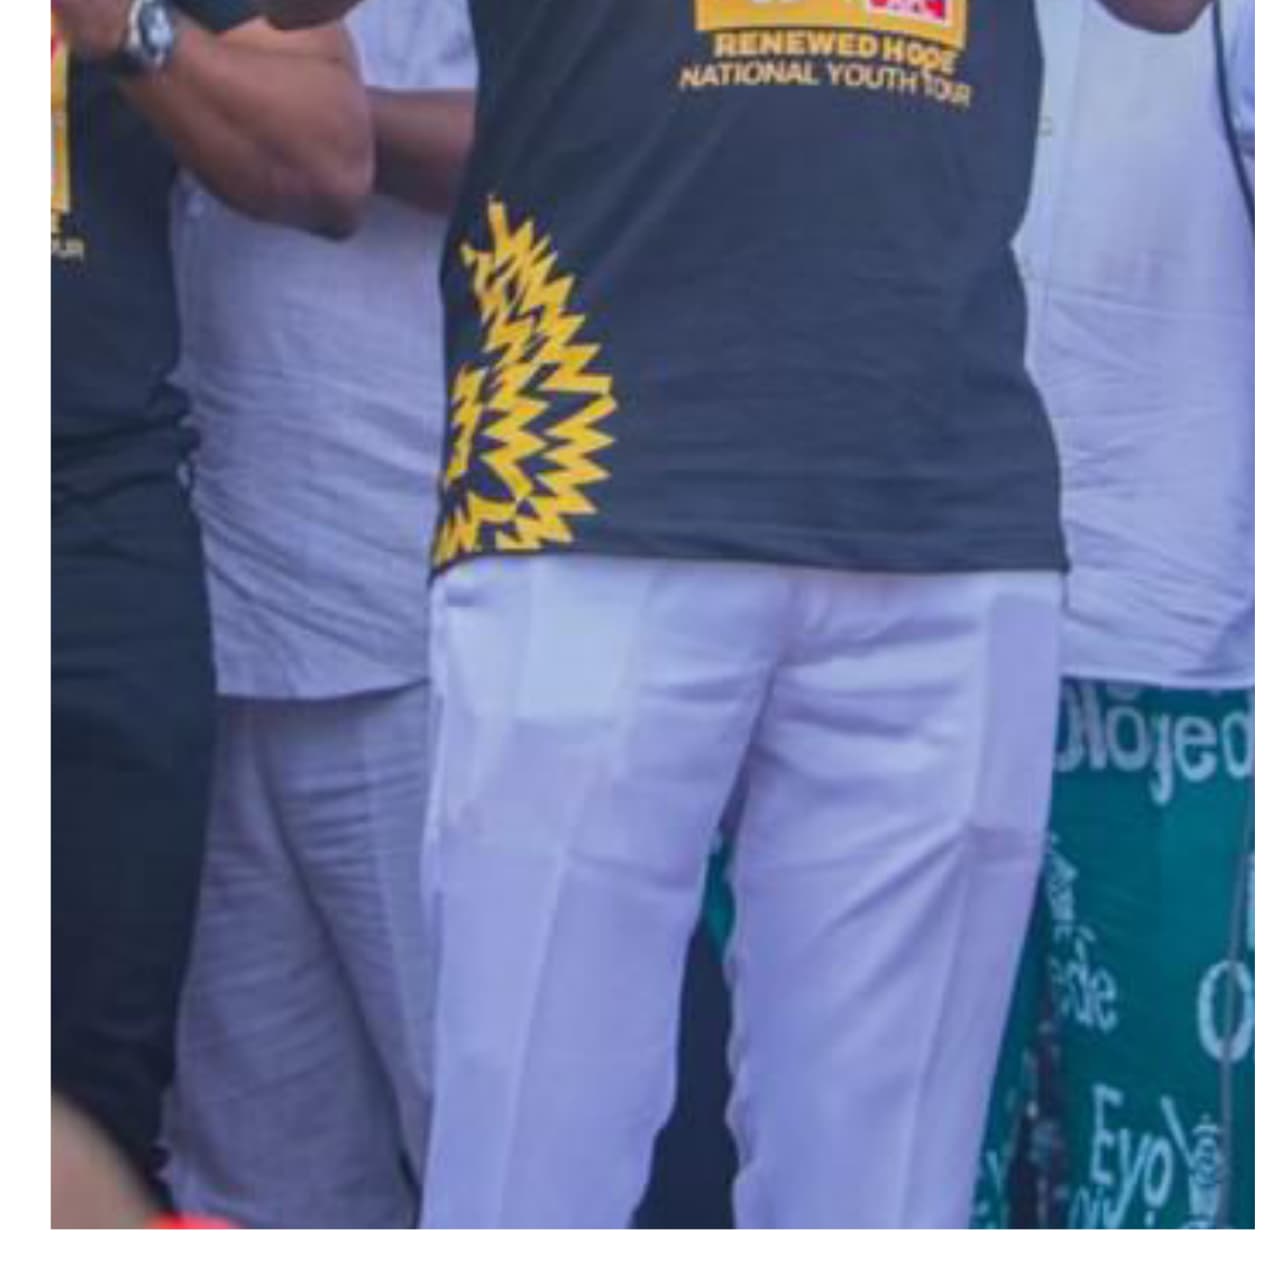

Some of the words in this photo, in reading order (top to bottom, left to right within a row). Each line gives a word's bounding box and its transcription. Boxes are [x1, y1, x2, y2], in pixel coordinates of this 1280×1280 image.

[714, 30, 879, 59] RENEWED
[679, 61, 820, 89] NATIONAL
[827, 62, 917, 93] YOUTH
